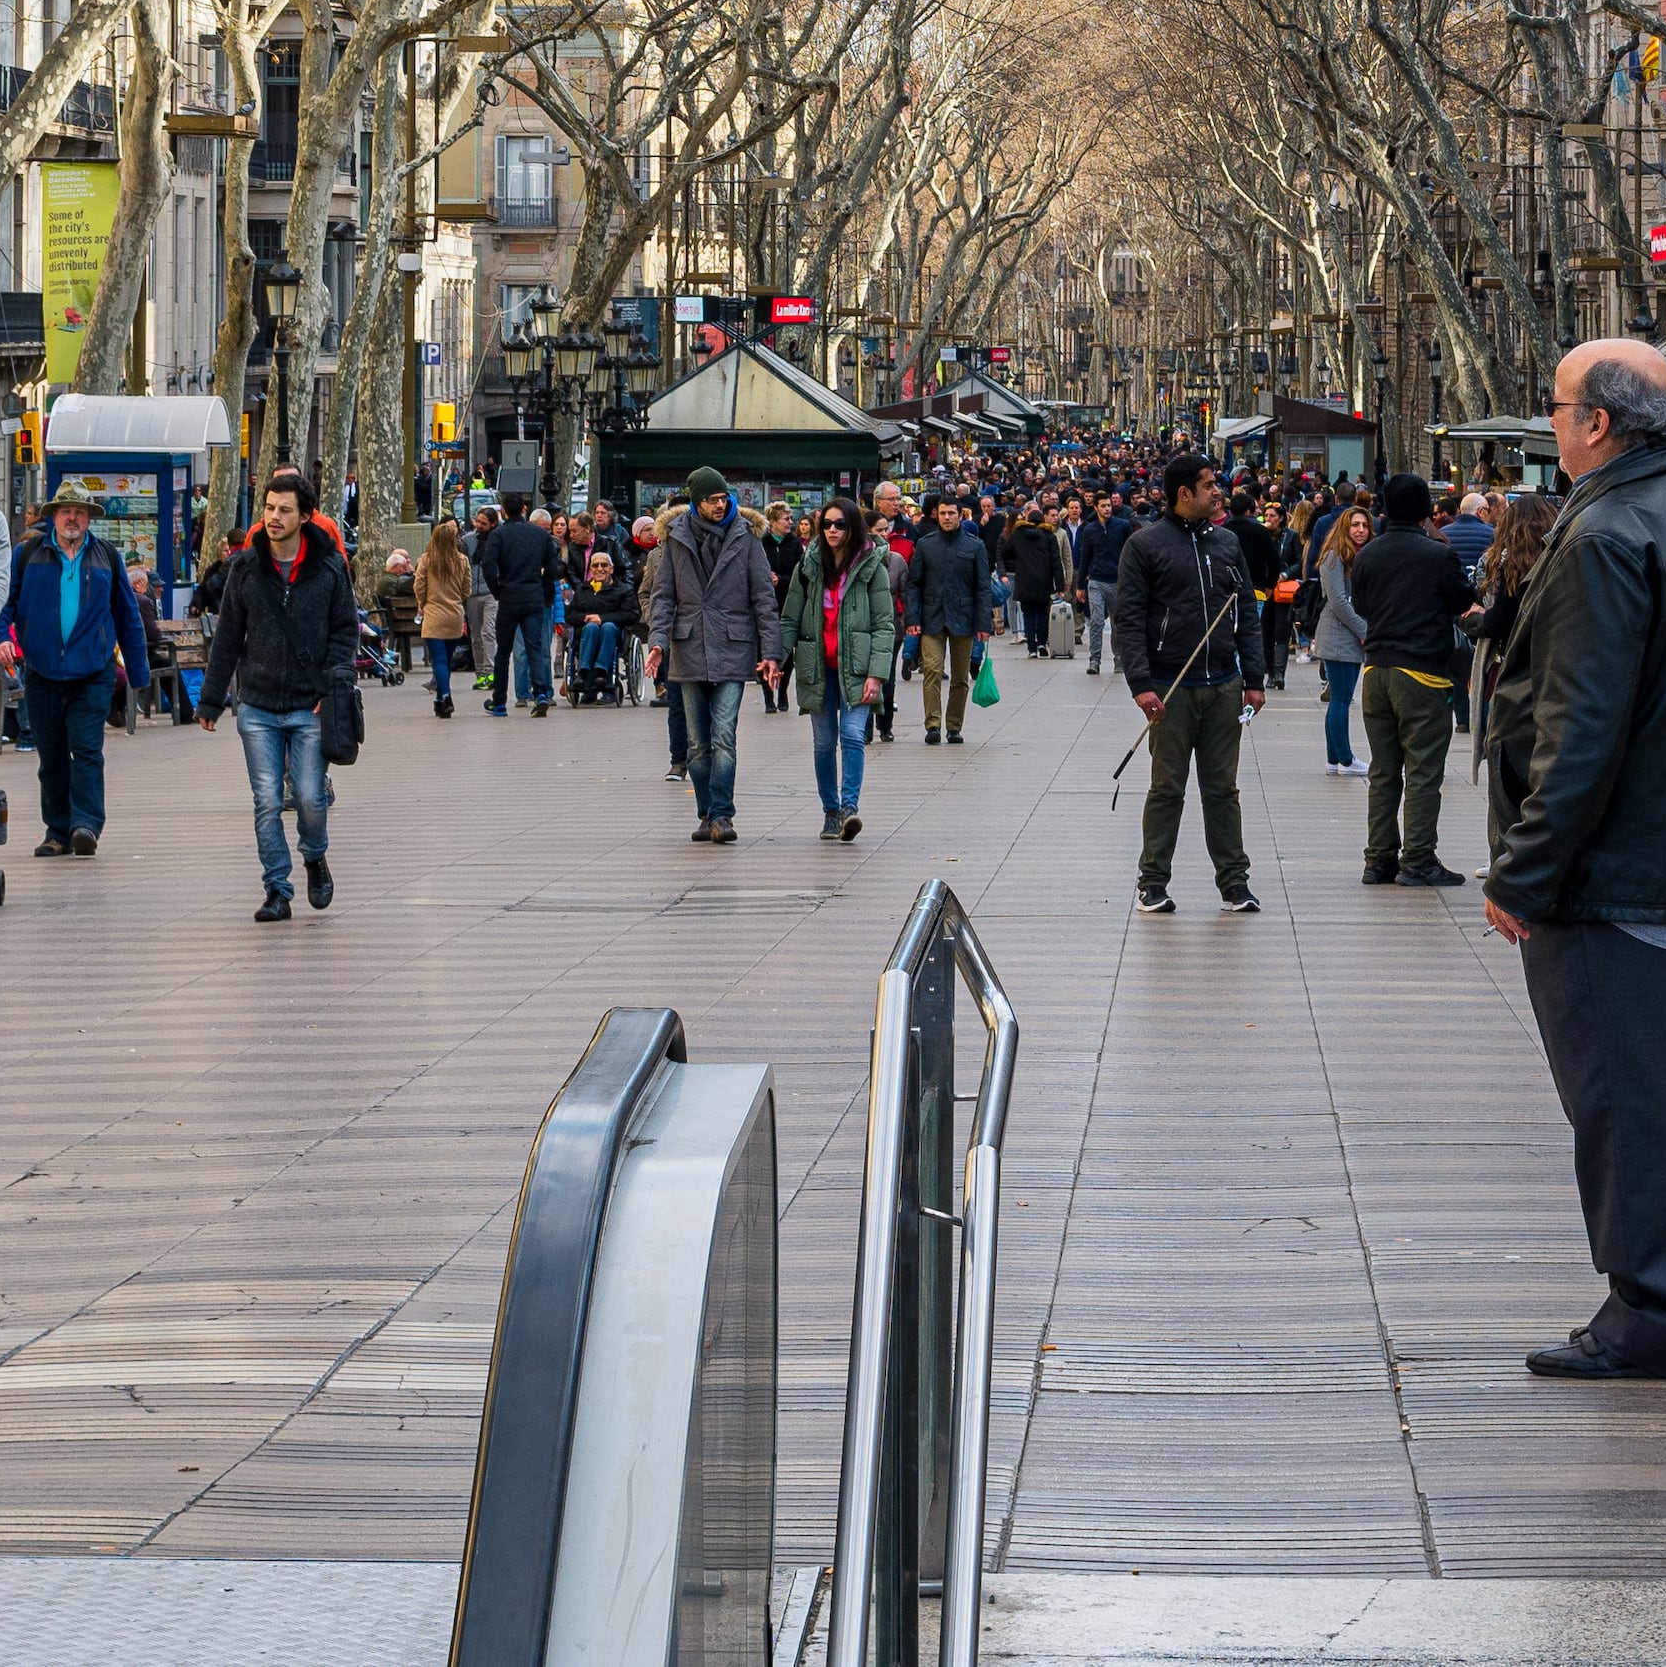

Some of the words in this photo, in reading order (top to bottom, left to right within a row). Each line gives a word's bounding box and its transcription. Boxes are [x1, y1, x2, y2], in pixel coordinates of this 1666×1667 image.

[48, 212, 72, 222] Some
[74, 209, 84, 220] of
[49, 224, 63, 235] the
[65, 221, 90, 235] city's
[49, 235, 92, 248] resources
[94, 235, 110, 244] are
[49, 247, 89, 260] unevenly
[49, 260, 98, 273] distributed
[427, 344, 440, 363] P
